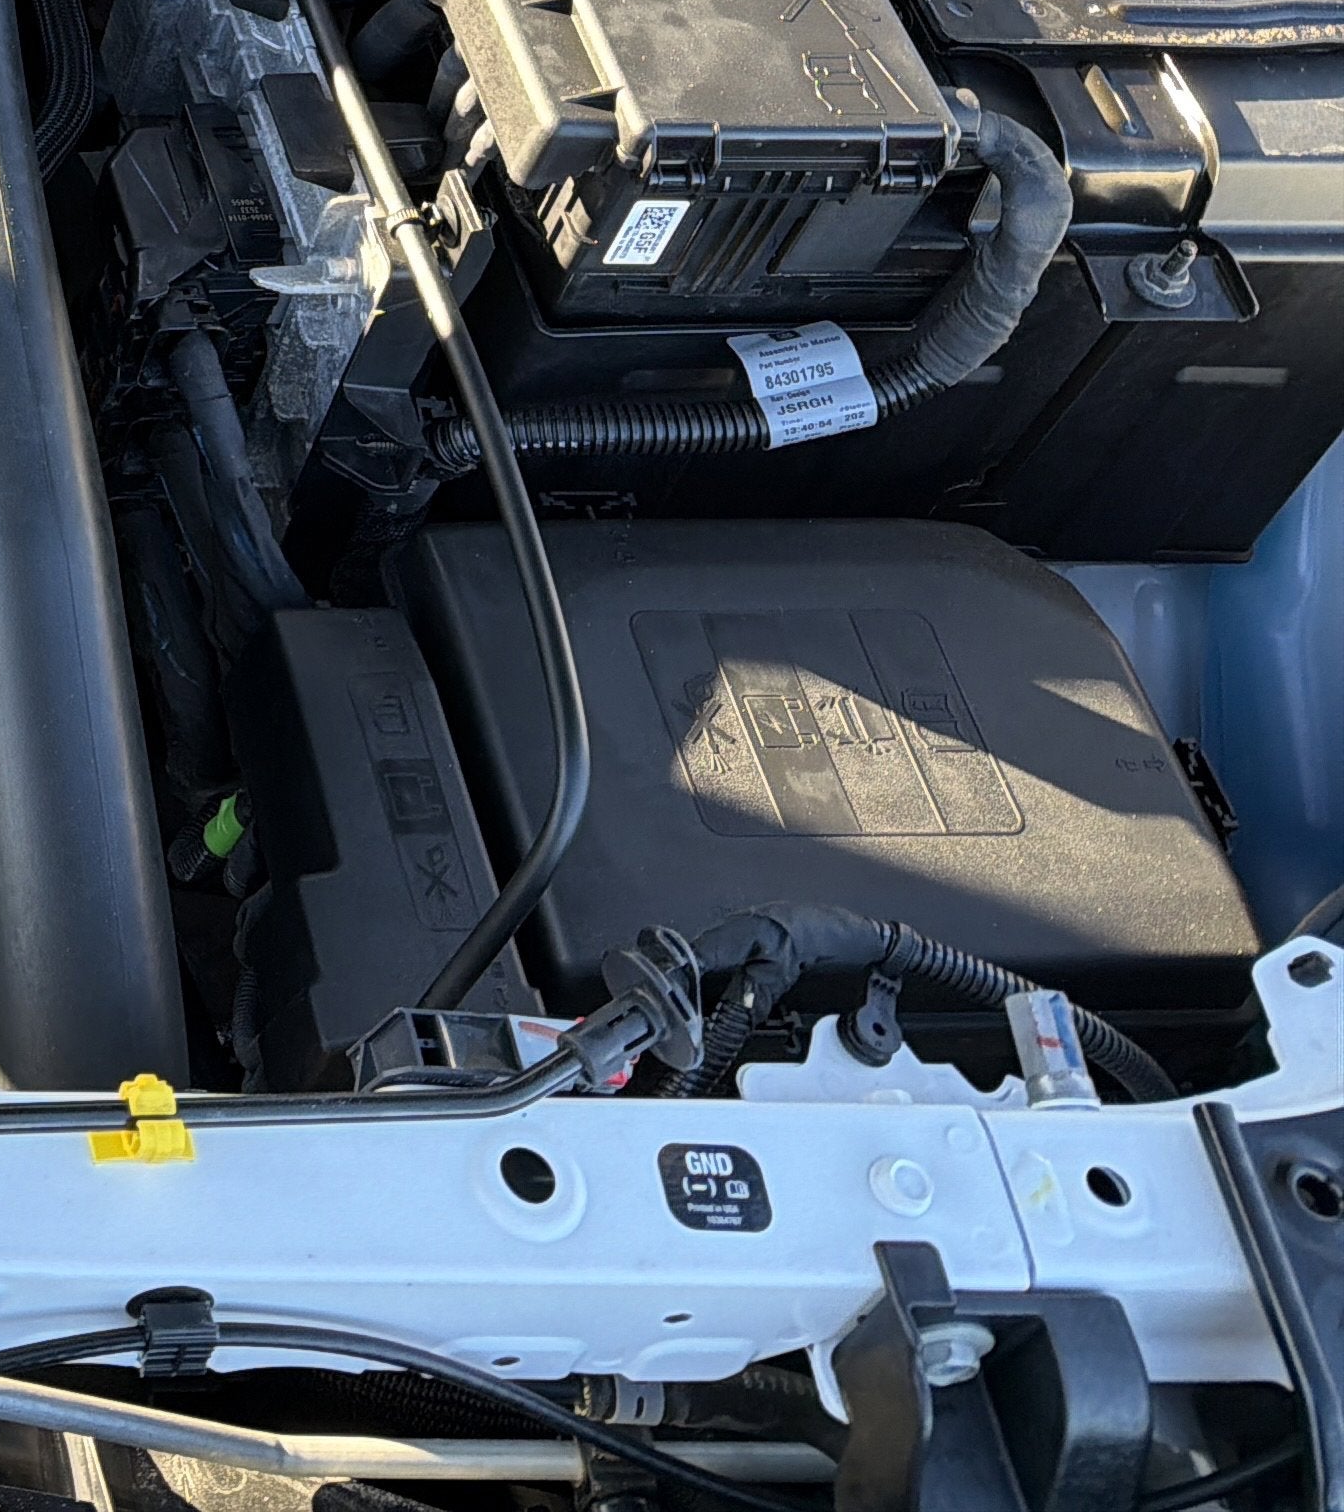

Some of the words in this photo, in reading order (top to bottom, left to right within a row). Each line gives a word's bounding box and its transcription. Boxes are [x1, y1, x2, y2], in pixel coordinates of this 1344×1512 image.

[764, 361, 835, 390] 84301795
[776, 394, 834, 416] JSRGH
[684, 1150, 734, 1177] GND
